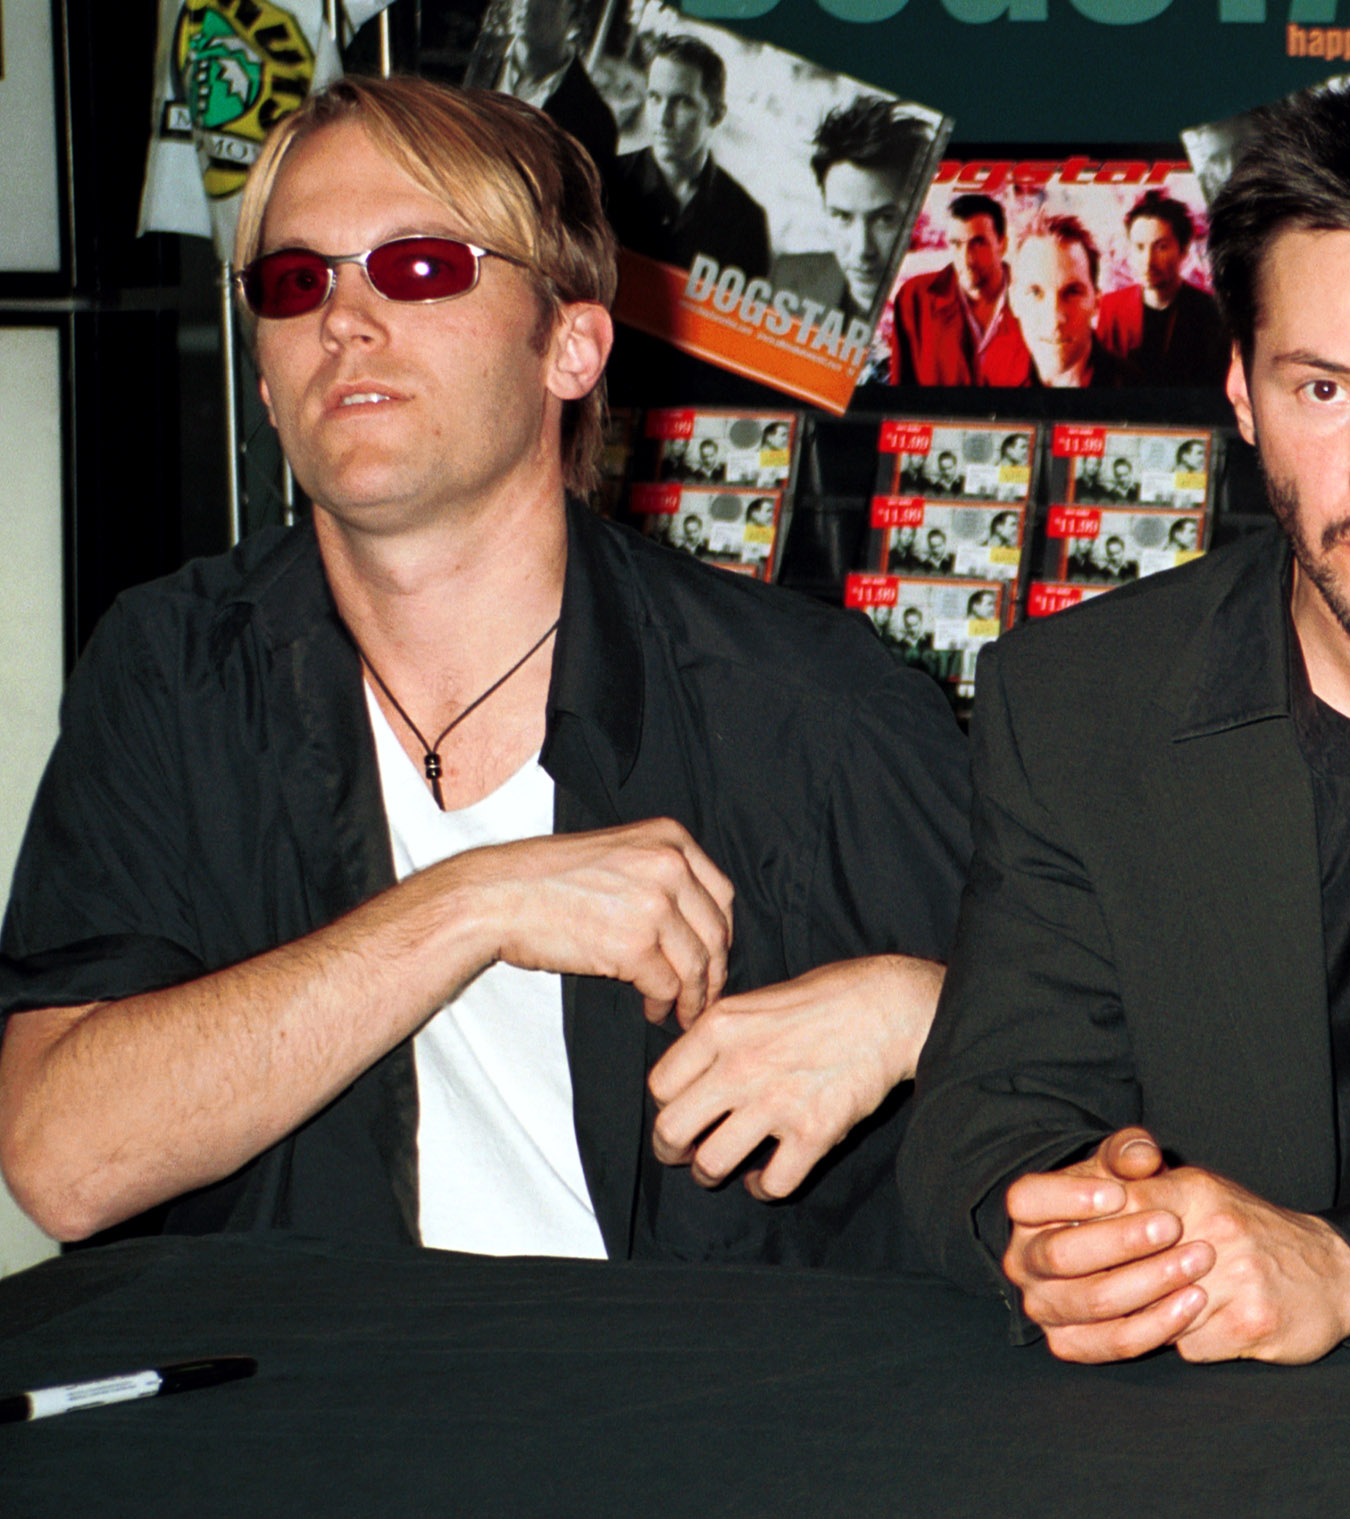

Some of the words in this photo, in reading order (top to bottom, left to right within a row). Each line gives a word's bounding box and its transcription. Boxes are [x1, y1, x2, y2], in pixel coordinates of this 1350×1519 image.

[684, 252, 873, 368] DOGSTAR
[886, 432, 930, 450] $11.99
[1059, 437, 1104, 452] $11.99
[877, 507, 923, 524] $11.99
[1054, 517, 1099, 533] $11.99
[852, 586, 897, 602] $11.99
